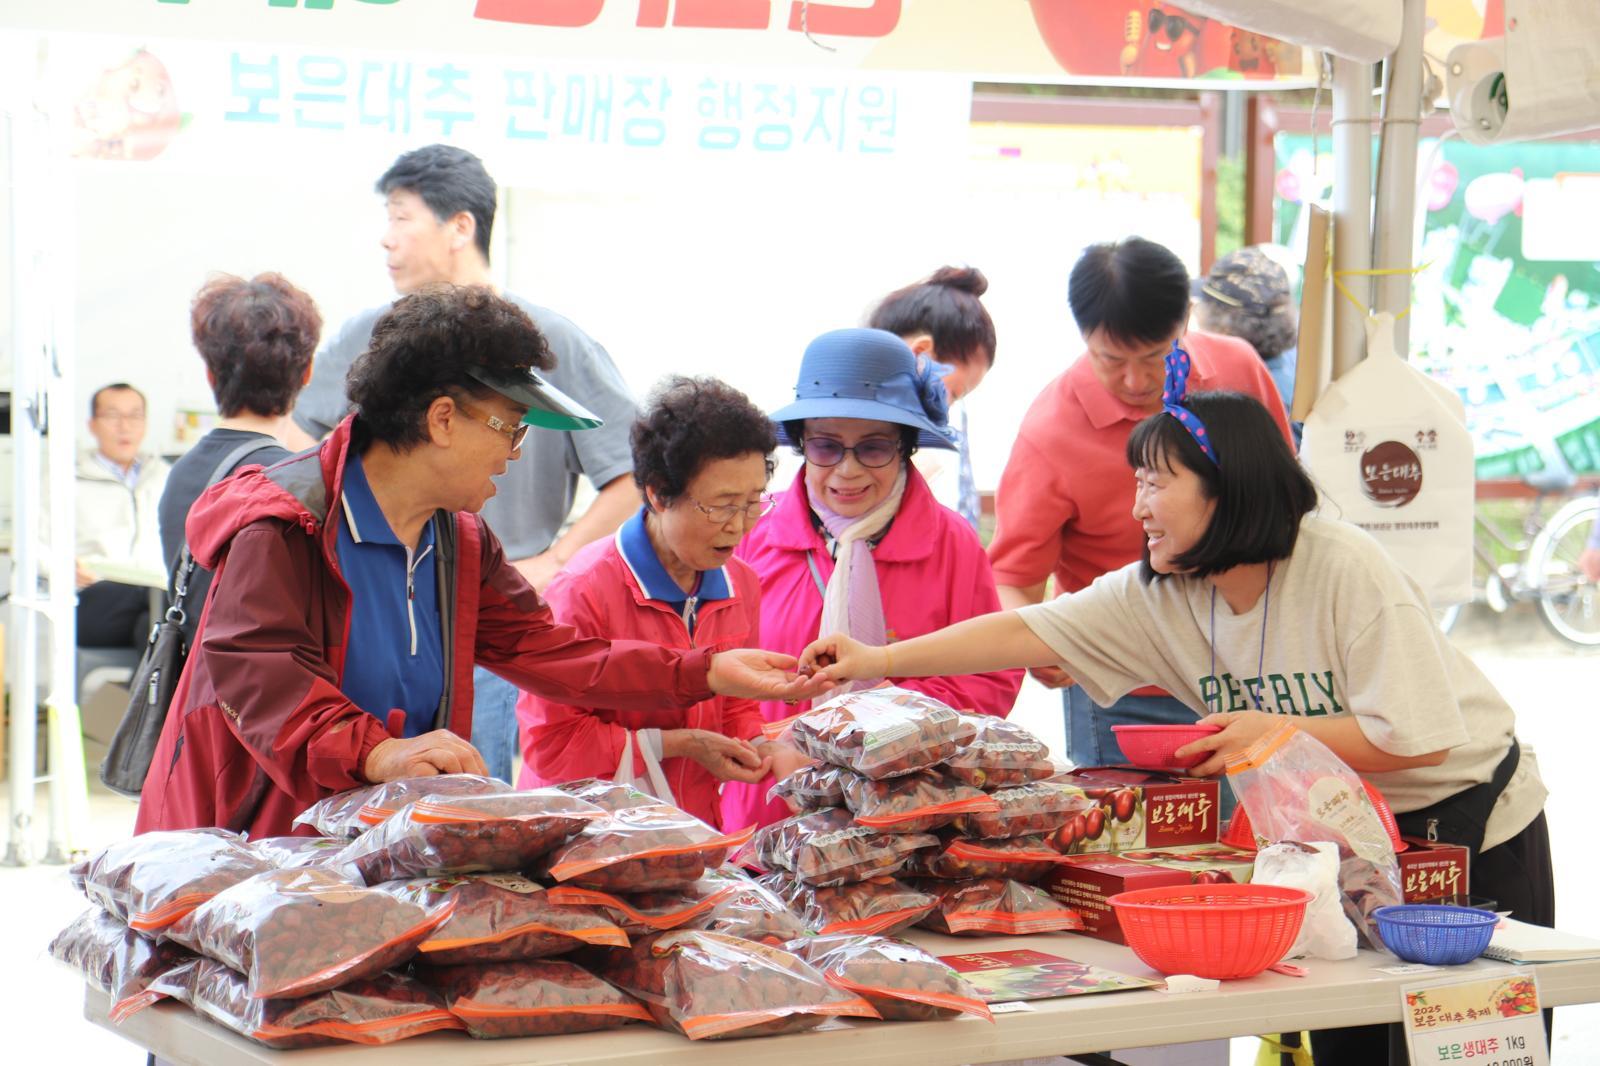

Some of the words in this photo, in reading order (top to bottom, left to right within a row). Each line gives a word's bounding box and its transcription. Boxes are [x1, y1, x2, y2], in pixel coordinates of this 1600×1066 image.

[224, 52, 475, 136] 보은대추
[503, 69, 673, 147] 판매장
[697, 76, 898, 154] 행정지원
[1364, 463, 1422, 482] 보은대추
[1150, 792, 1212, 833] 보은대추
[1405, 860, 1462, 897] 보은대추
[1414, 1004, 1442, 1015] 2025
[1437, 1038, 1499, 1061] 보은생대추
[1505, 1036, 1526, 1050] 1kg
